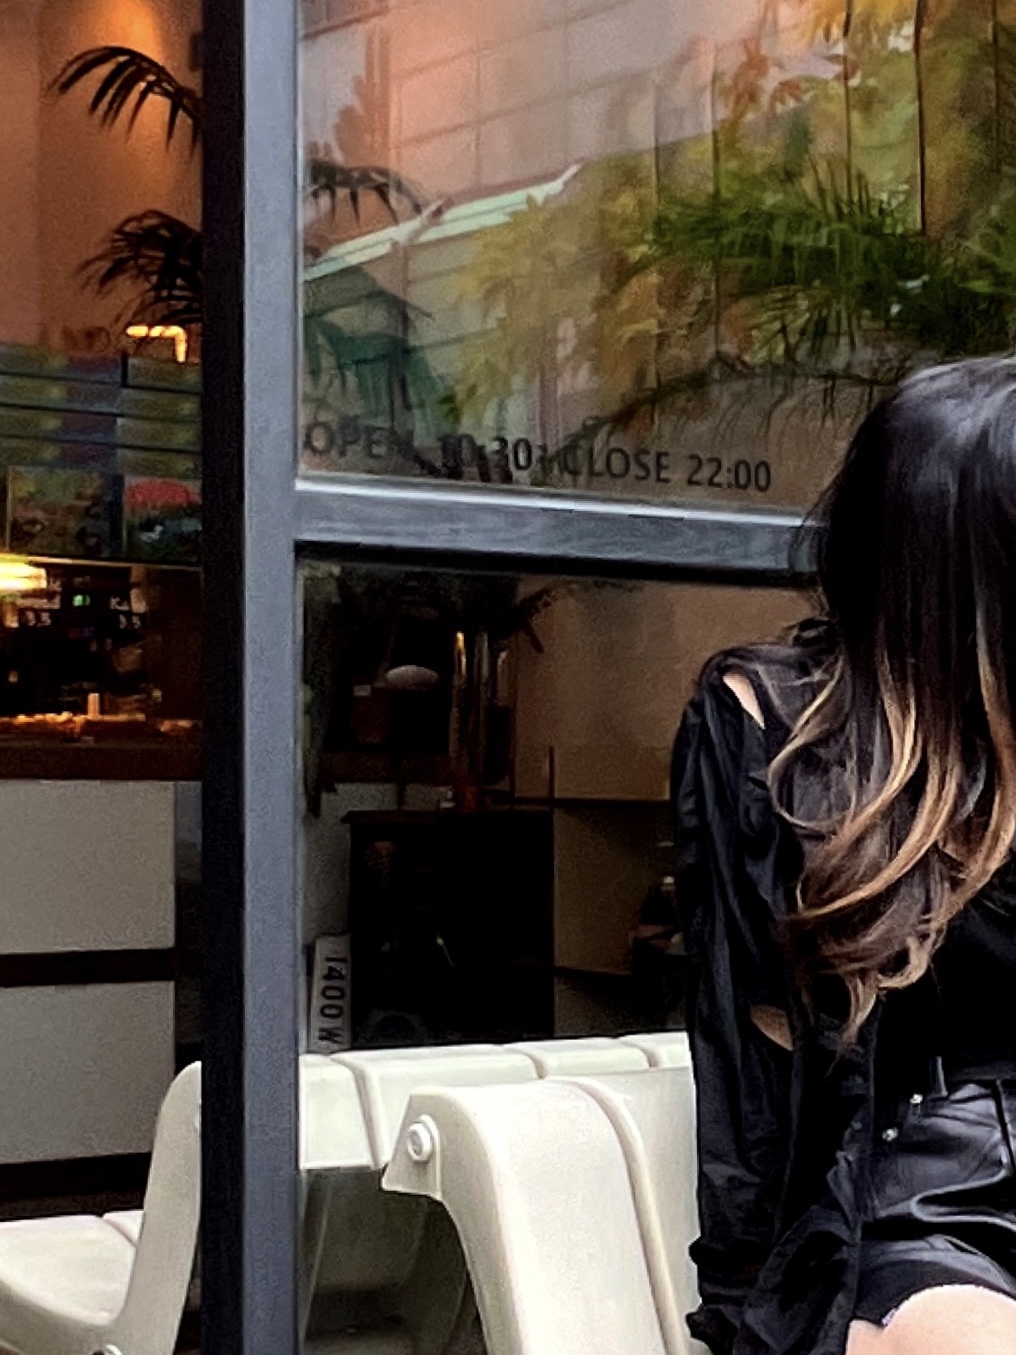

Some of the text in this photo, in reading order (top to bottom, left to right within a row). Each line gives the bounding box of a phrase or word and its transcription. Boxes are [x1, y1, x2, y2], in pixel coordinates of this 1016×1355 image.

[304, 420, 415, 458] OPEN
[563, 441, 670, 484] CLOSE
[686, 454, 772, 492] 22:00
[319, 956, 348, 1019] 1400
